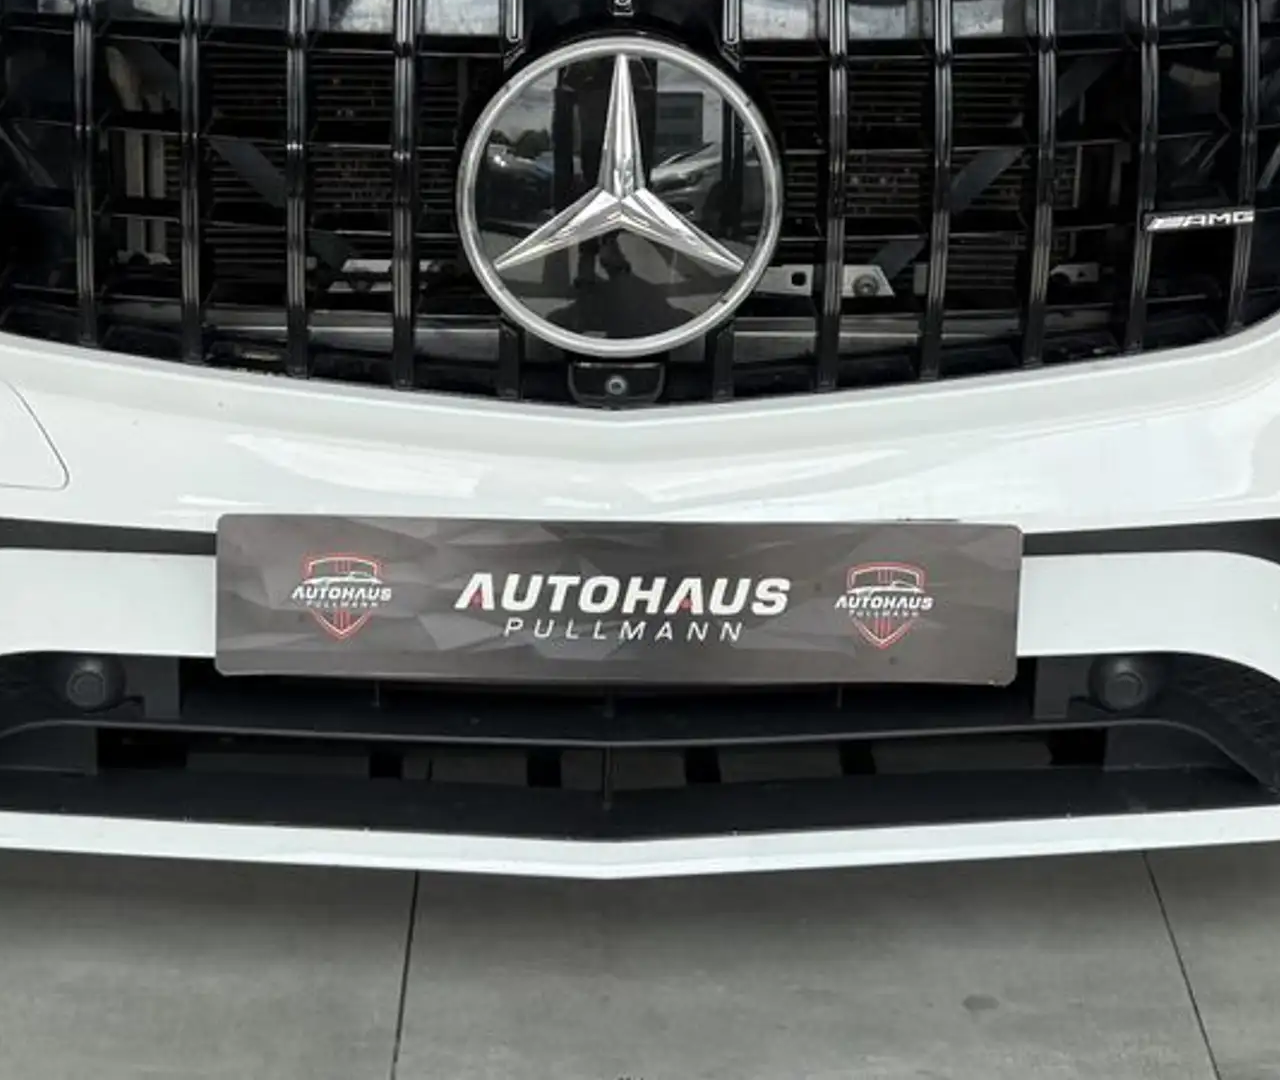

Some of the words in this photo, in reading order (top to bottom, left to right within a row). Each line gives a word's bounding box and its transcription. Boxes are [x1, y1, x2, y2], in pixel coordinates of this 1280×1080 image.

[291, 585, 392, 601] AUTOHAUS
[455, 572, 791, 616] AUTOHAUS
[834, 595, 934, 611] AUTOHAUS
[503, 617, 742, 642] PULLMANN
